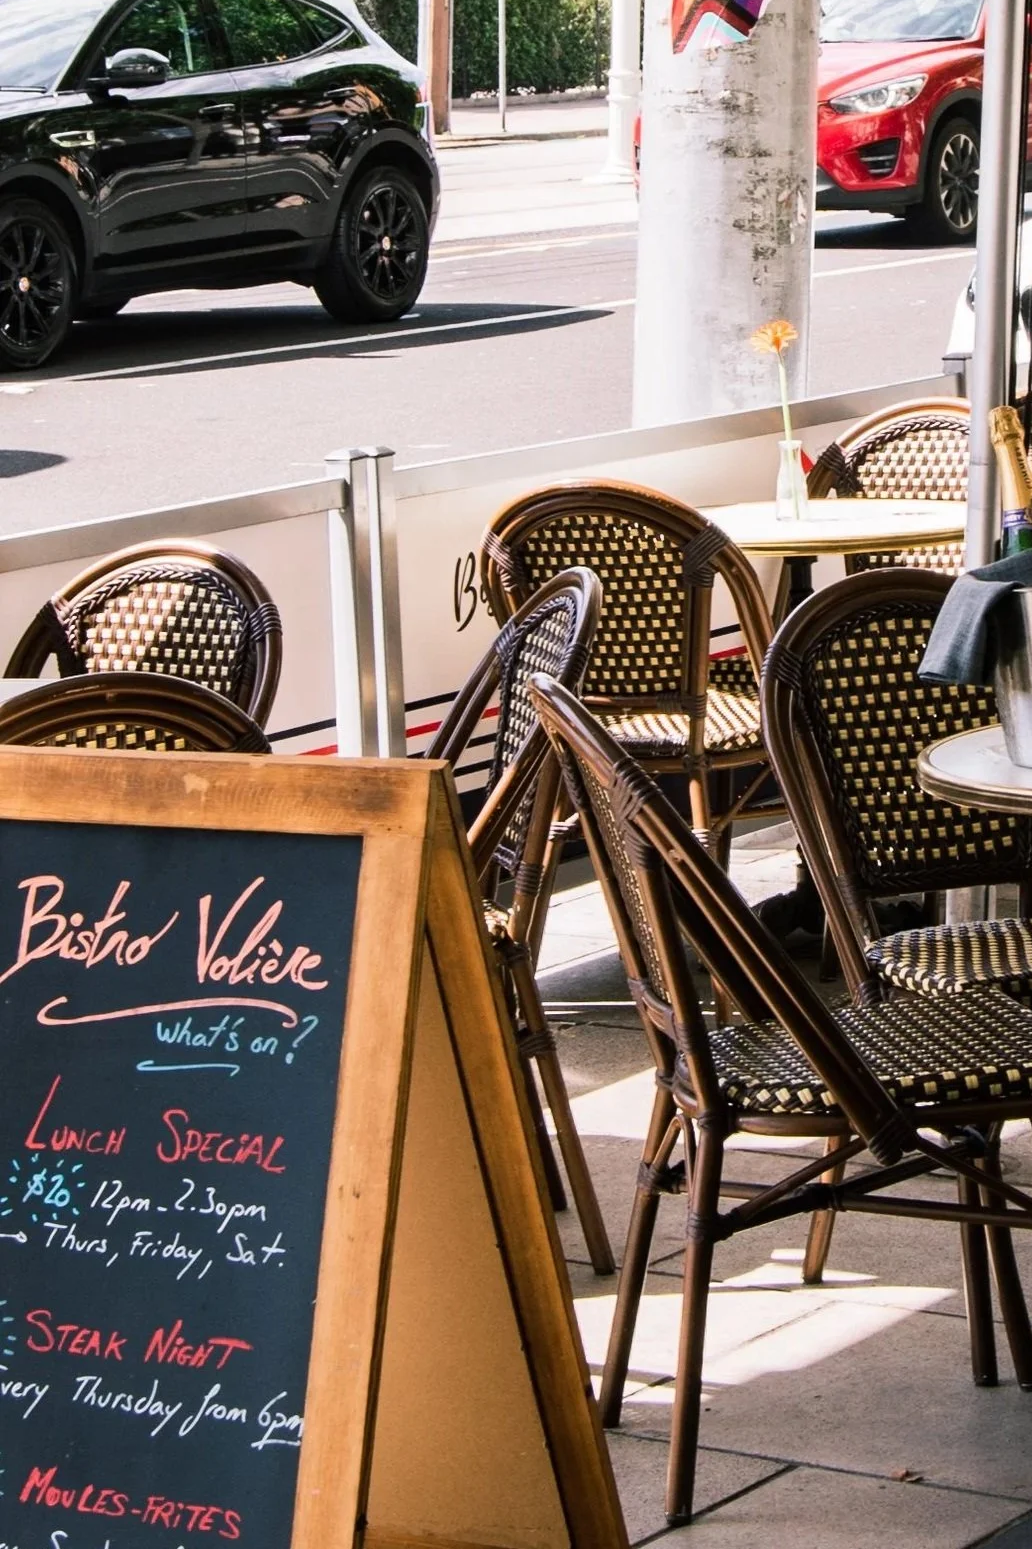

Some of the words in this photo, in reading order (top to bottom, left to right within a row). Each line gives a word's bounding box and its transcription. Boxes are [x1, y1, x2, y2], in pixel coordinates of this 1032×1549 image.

[0, 875, 179, 983] Bistro
[198, 876, 328, 990] Volière
[25, 1075, 126, 1154] LUNCH
[23, 1169, 70, 1207] $20
[44, 1222, 119, 1267] Thurs,
[129, 1231, 213, 1280] Friday,
[26, 1309, 127, 1362] STEAK
[0, 1364, 49, 1420] very
[72, 1376, 182, 1437] Thursday
[178, 1383, 248, 1438] from
